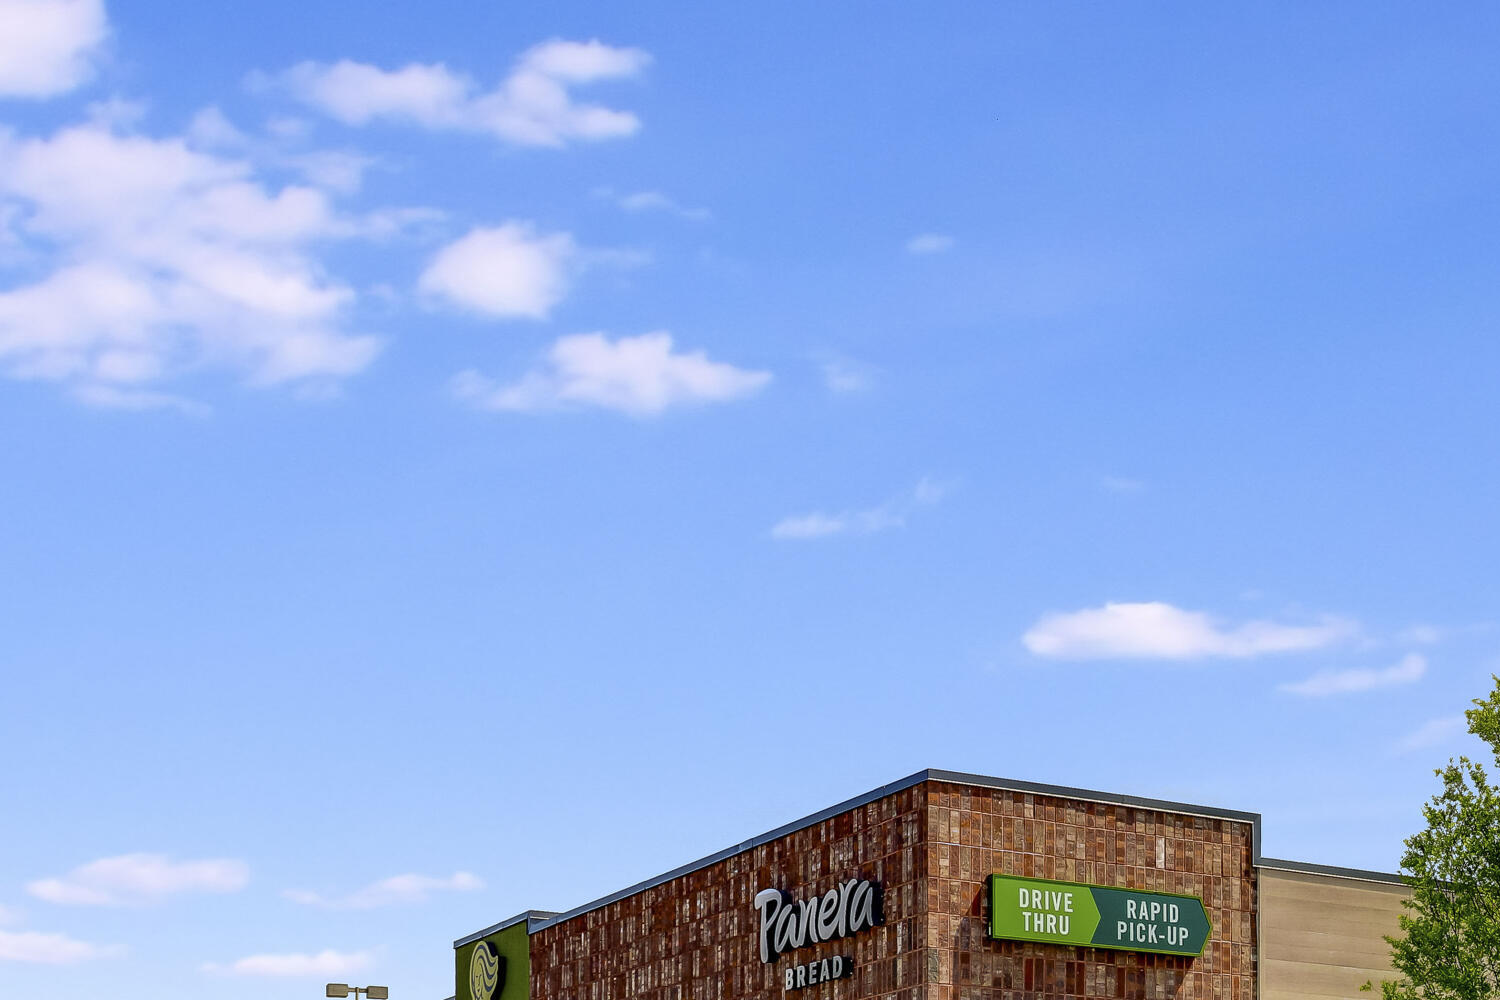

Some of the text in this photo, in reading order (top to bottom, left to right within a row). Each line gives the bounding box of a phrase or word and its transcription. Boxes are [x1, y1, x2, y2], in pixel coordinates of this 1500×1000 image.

[1018, 887, 1074, 913] DRIVE
[1126, 899, 1179, 923] RAPID
[754, 878, 874, 964] Panera
[1022, 911, 1071, 936] THRU
[1117, 920, 1189, 946] PICK-UP
[785, 955, 843, 991] BREAD
